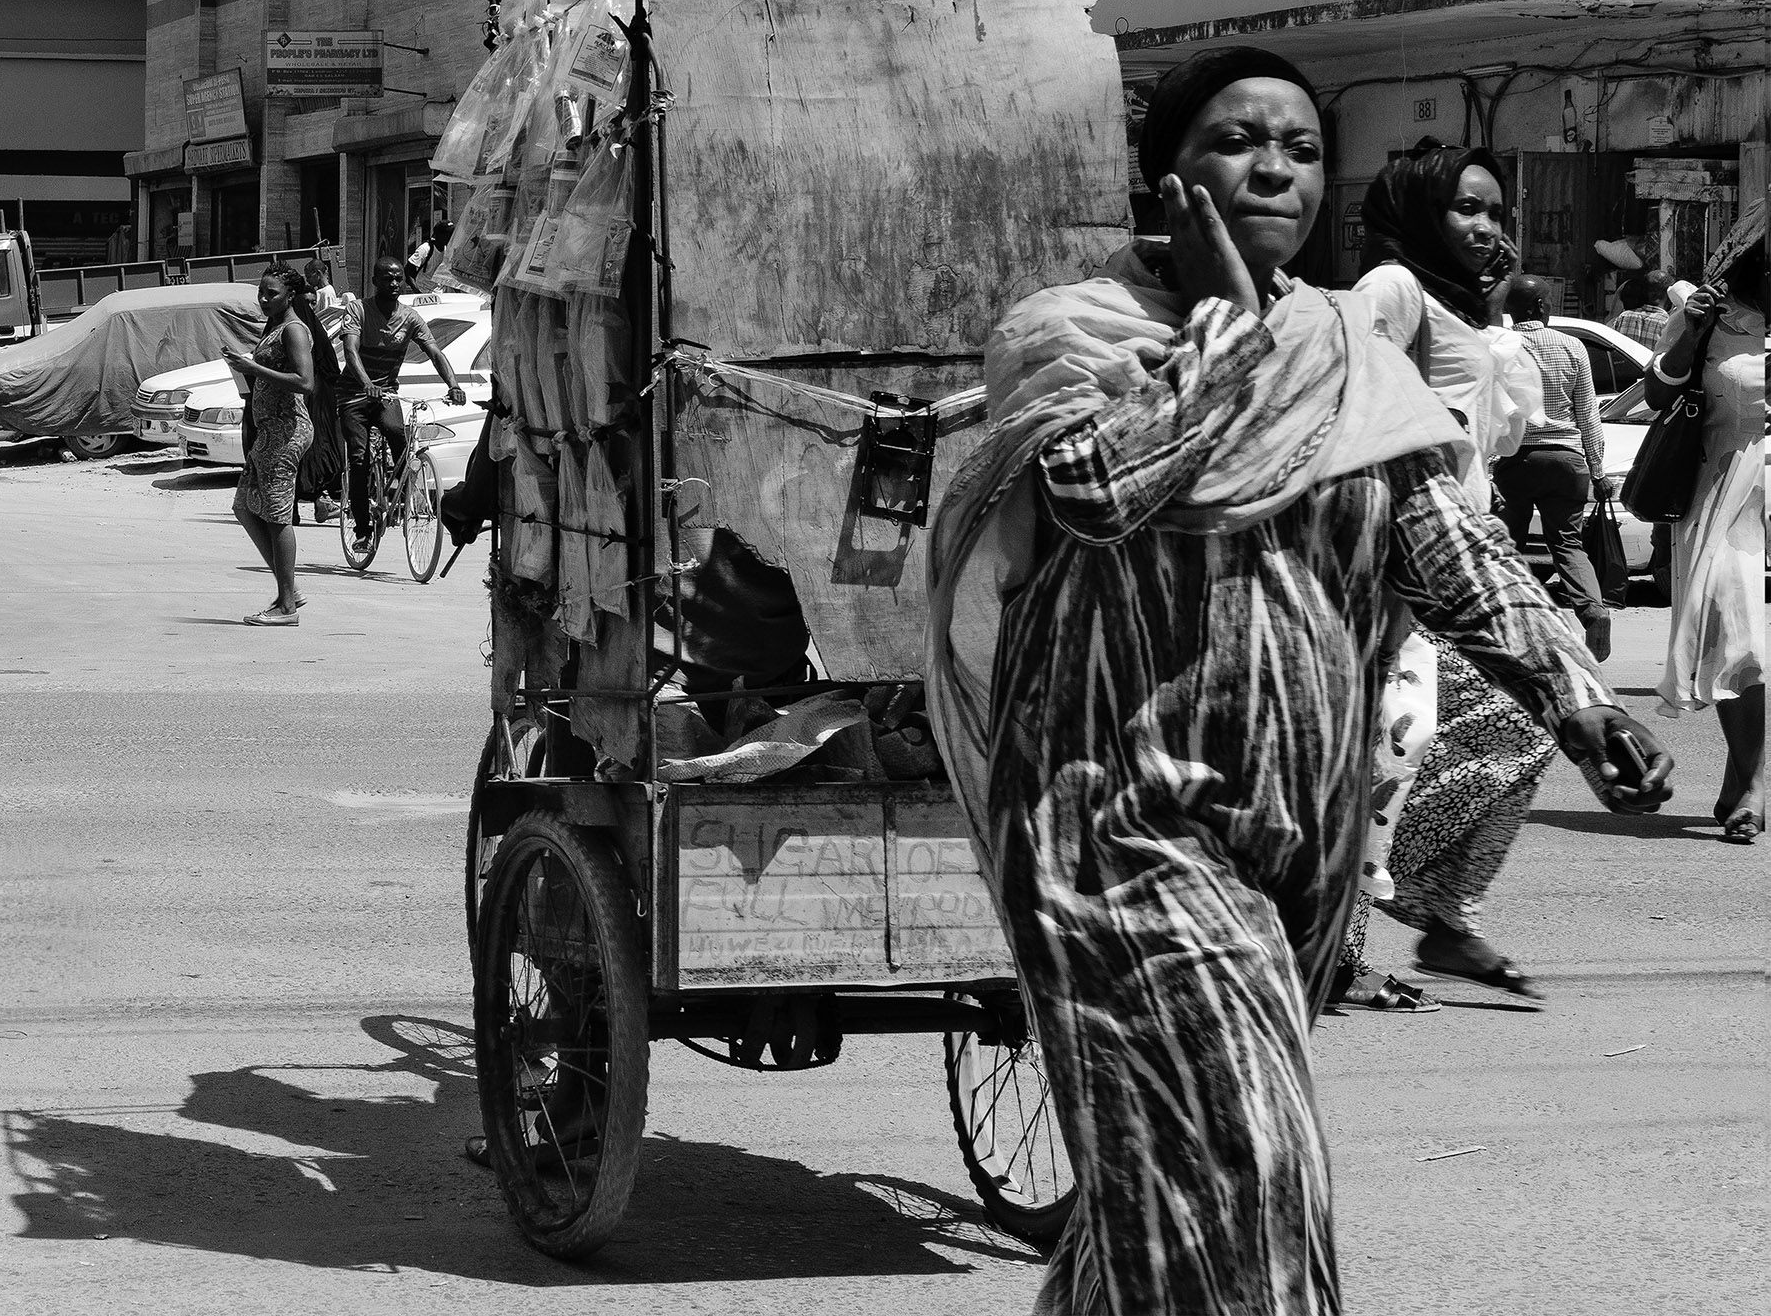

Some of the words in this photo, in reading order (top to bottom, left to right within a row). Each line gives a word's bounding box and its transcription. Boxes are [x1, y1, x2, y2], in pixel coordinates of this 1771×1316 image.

[315, 36, 333, 47] THE
[270, 48, 312, 59] PEOPLE'S
[314, 48, 361, 59] PHARMACY
[362, 48, 379, 59] LTD
[1418, 101, 1431, 119] 88
[417, 295, 438, 305] TAXI
